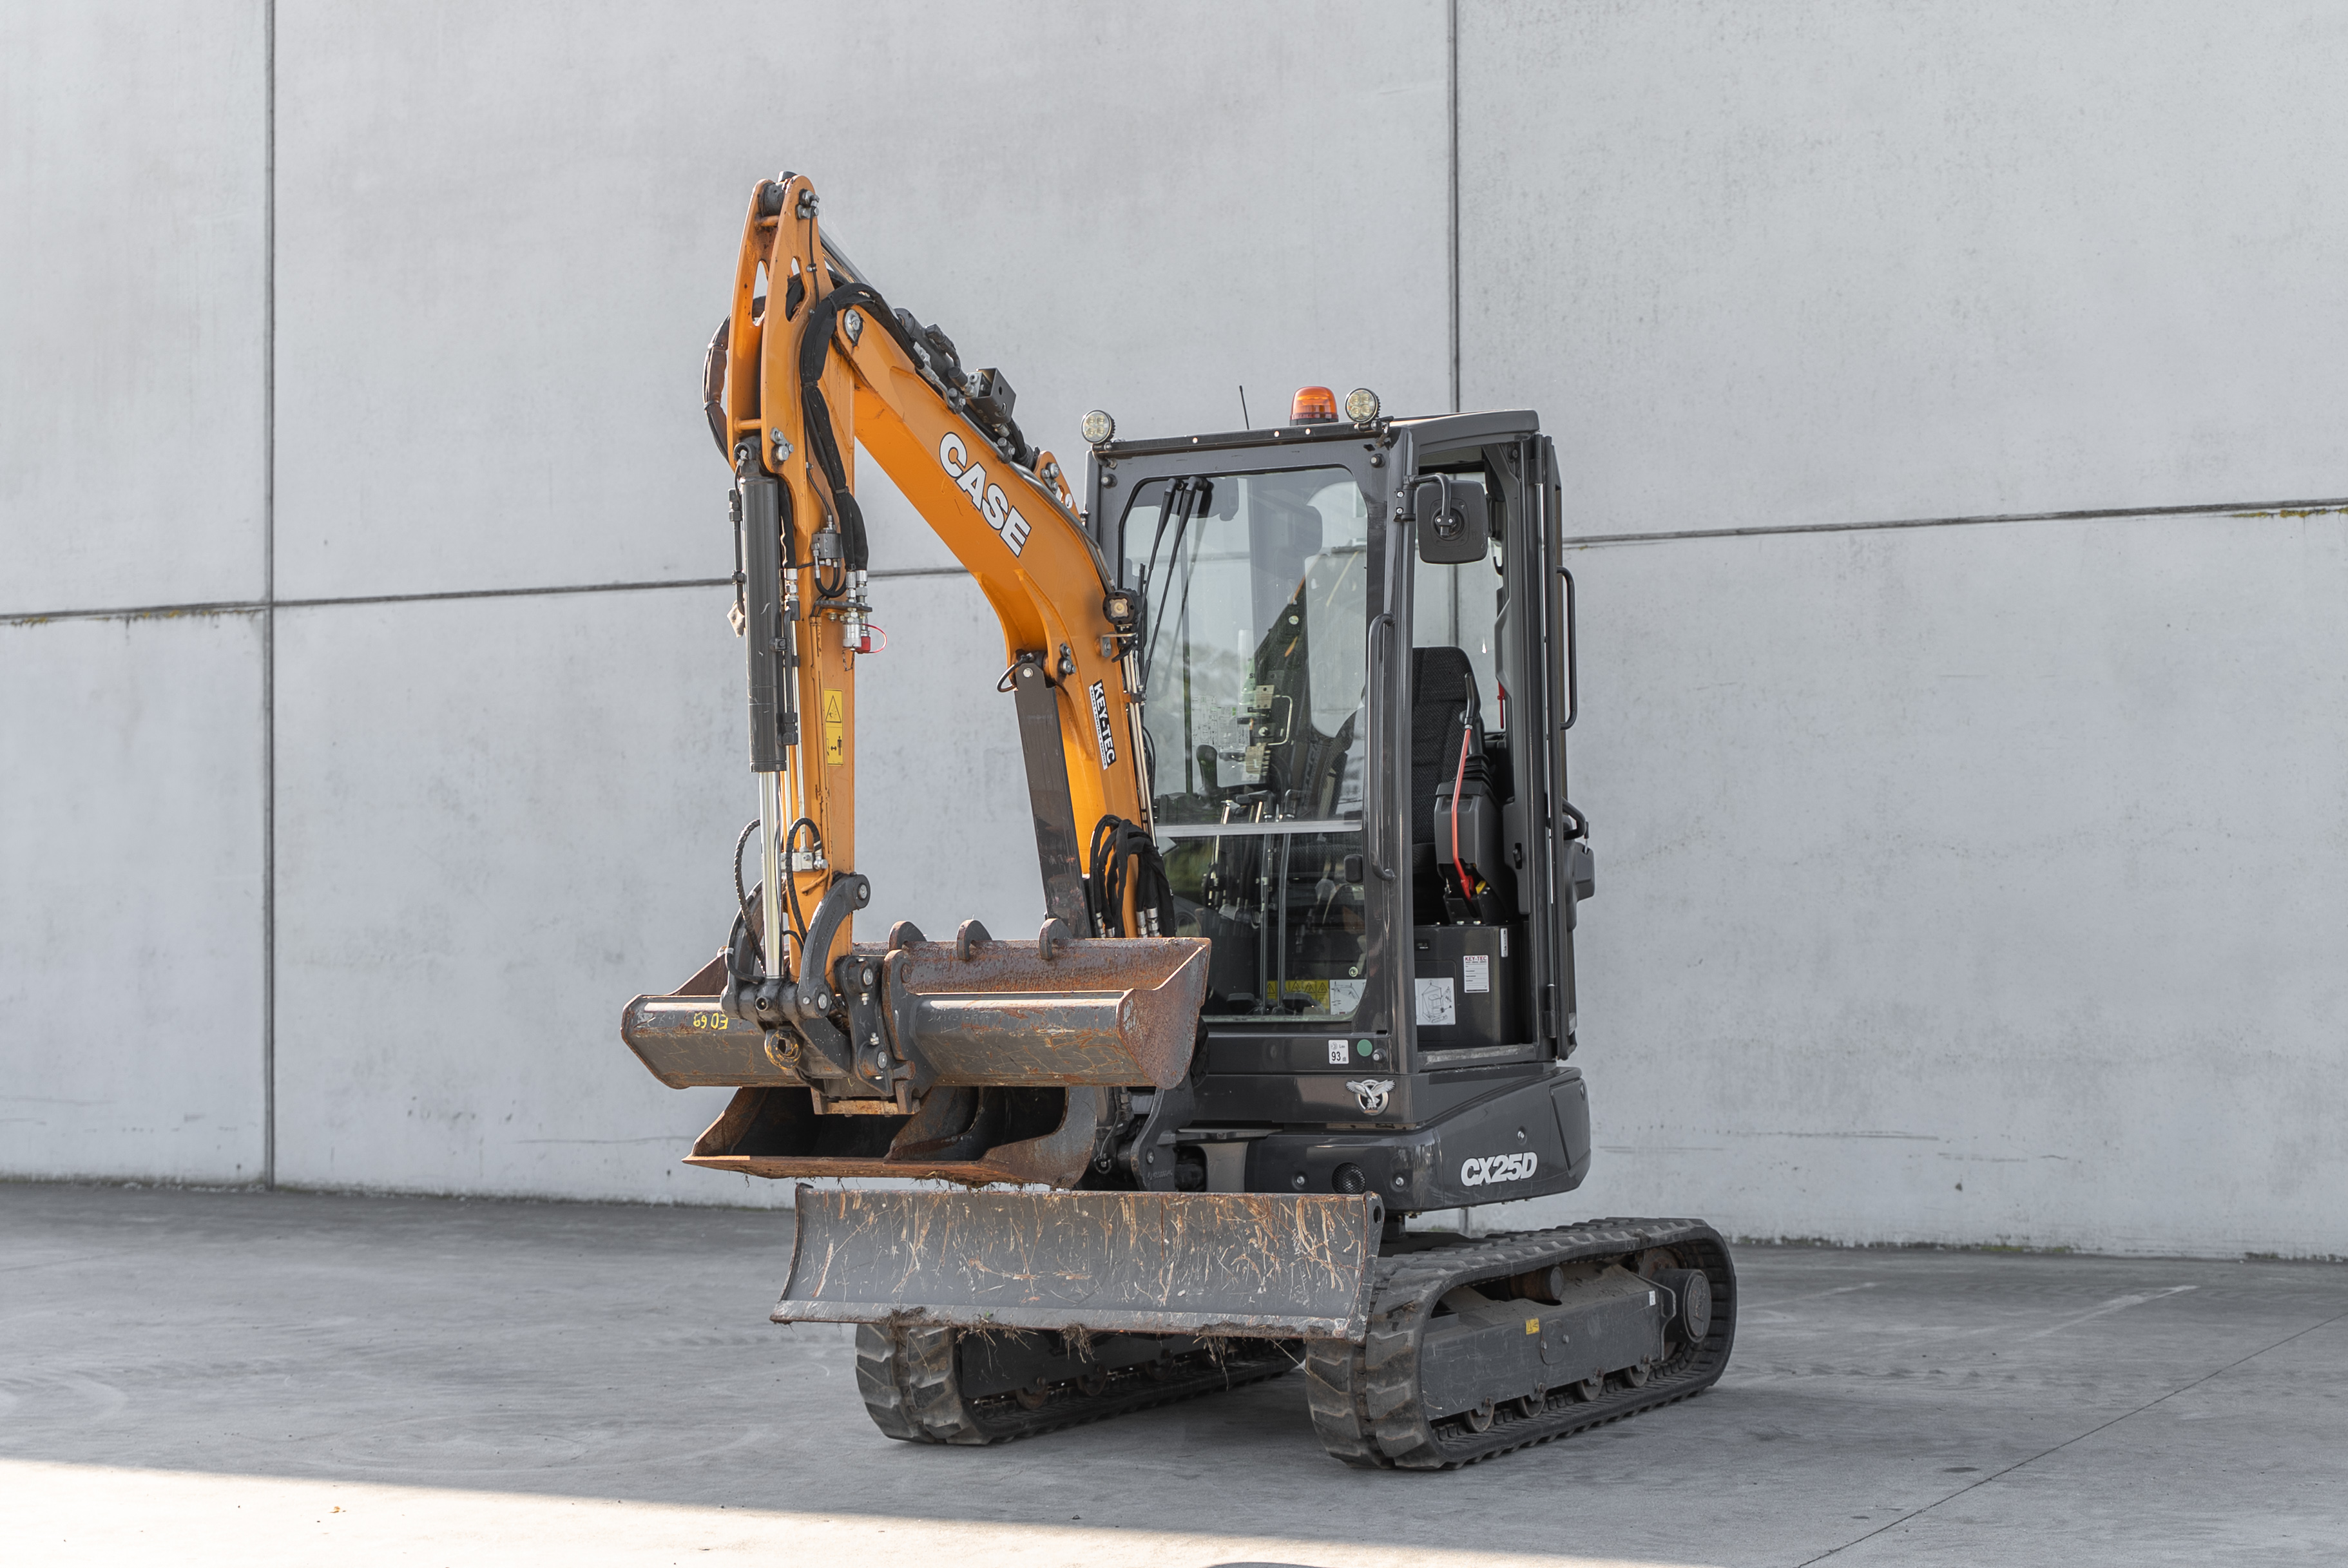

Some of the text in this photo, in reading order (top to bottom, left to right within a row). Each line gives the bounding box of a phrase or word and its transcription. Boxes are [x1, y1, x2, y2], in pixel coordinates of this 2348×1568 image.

[939, 432, 1032, 558] CASE
[1094, 682, 1115, 763] KEY-TEC
[1331, 1051, 1341, 1062] 93
[1461, 1152, 1538, 1187] CX25D
